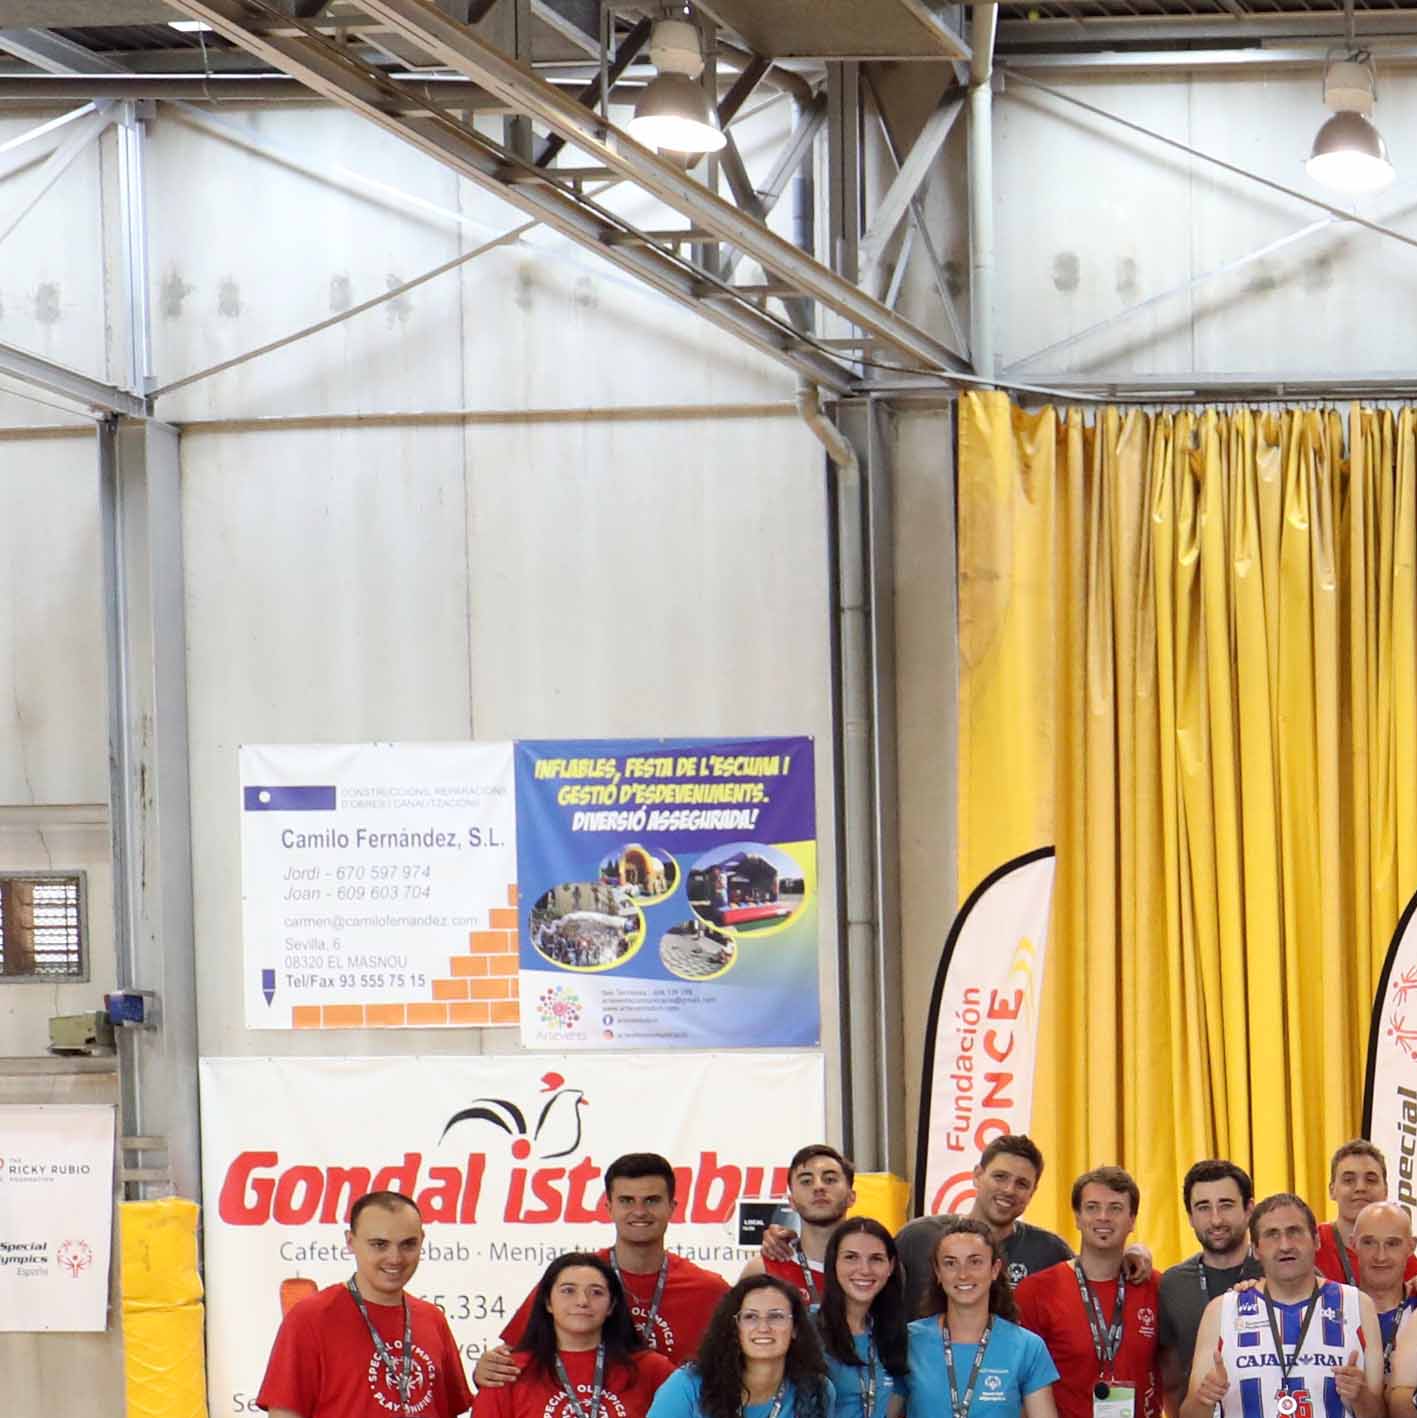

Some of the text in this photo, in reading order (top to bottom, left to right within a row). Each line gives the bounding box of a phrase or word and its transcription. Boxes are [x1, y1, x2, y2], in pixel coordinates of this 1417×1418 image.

[625, 758, 673, 778] FESTA
[676, 757, 696, 777] DE
[557, 781, 618, 806] GESTIÓ
[572, 805, 647, 832] DIVERSIÓ
[281, 827, 505, 850] Camilo Fernández, S.L.
[284, 865, 431, 880] Jordi 670 597 974
[284, 887, 321, 901] Joan
[371, 886, 398, 900] 603
[403, 886, 431, 900] 704
[285, 938, 327, 951] Sevilla,
[284, 955, 407, 969] 08320 EL MASNOU
[286, 974, 425, 988] Tel/Fax 93 555 75 15
[946, 987, 981, 1152] Fundación
[974, 989, 1024, 1152] ONCE
[9, 1165, 90, 1175] RICKY RUBIO
[219, 1151, 486, 1226] Gondal
[418, 1242, 469, 1261] ebab
[1236, 1354, 1279, 1368] CAJA
